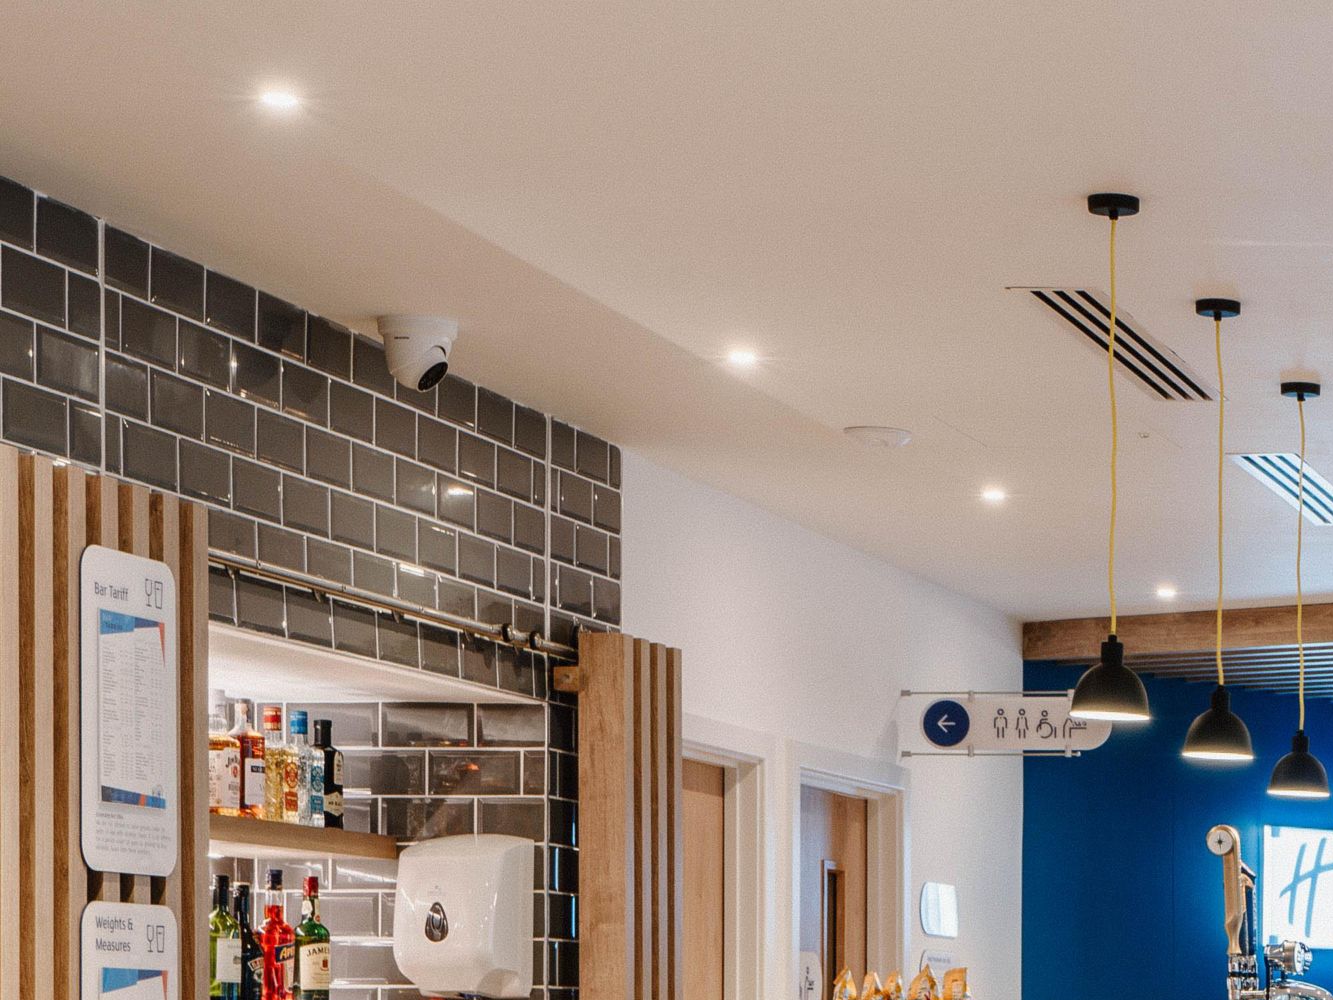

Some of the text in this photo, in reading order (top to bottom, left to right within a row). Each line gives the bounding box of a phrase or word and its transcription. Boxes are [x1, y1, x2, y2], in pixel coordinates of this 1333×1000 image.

[94, 581, 128, 601] Bar Tariff
[95, 916, 133, 934] Weights &
[95, 938, 131, 952] Measures
